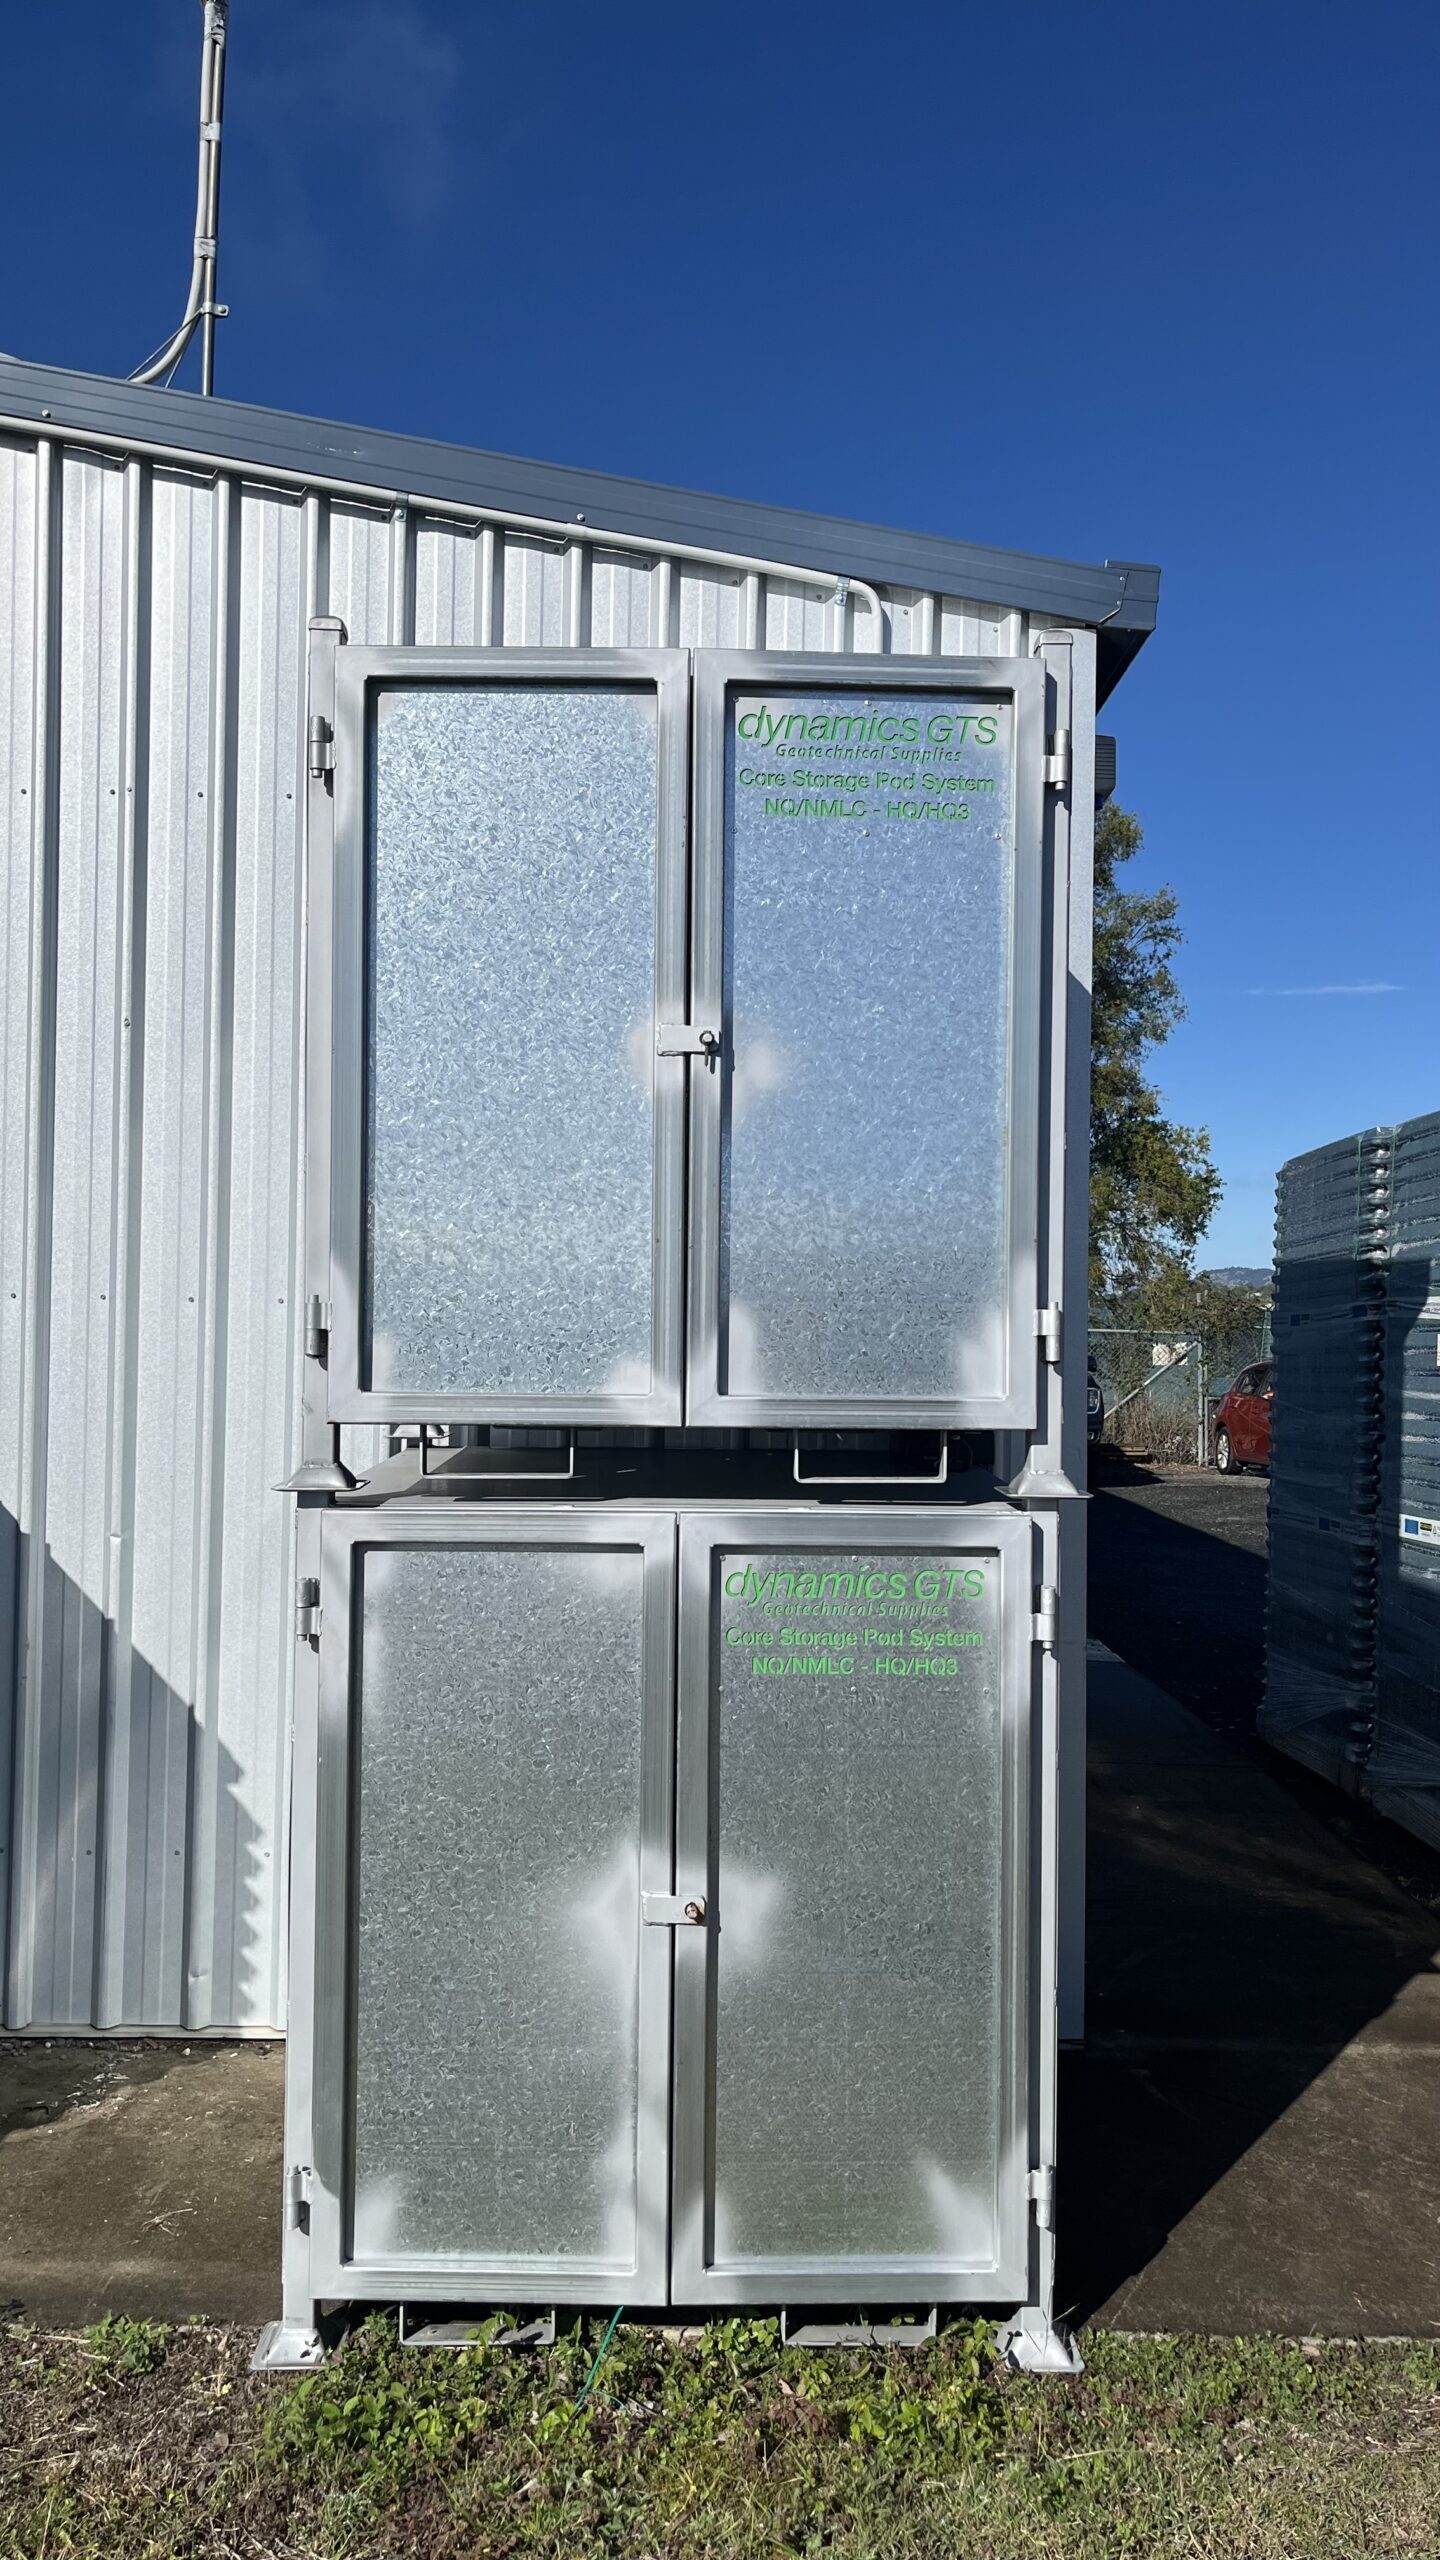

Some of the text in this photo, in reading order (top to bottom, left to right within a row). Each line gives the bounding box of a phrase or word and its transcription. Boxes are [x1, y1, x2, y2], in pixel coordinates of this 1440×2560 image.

[737, 705, 998, 747] dynamics GTS
[775, 743, 962, 763] Geotechnical Supplies
[739, 768, 995, 794] Core Storage Pod System
[764, 798, 867, 817] NQ/NMLC
[887, 801, 970, 820] HQ/HQ3
[725, 1564, 985, 1606] dynamics GTS
[762, 1601, 949, 1619] Geotechnical Supplies
[725, 1627, 984, 1650] Core Storage Pod System
[752, 1656, 855, 1675] NQ/NMLC
[874, 1657, 958, 1676] HQ/HQ3
